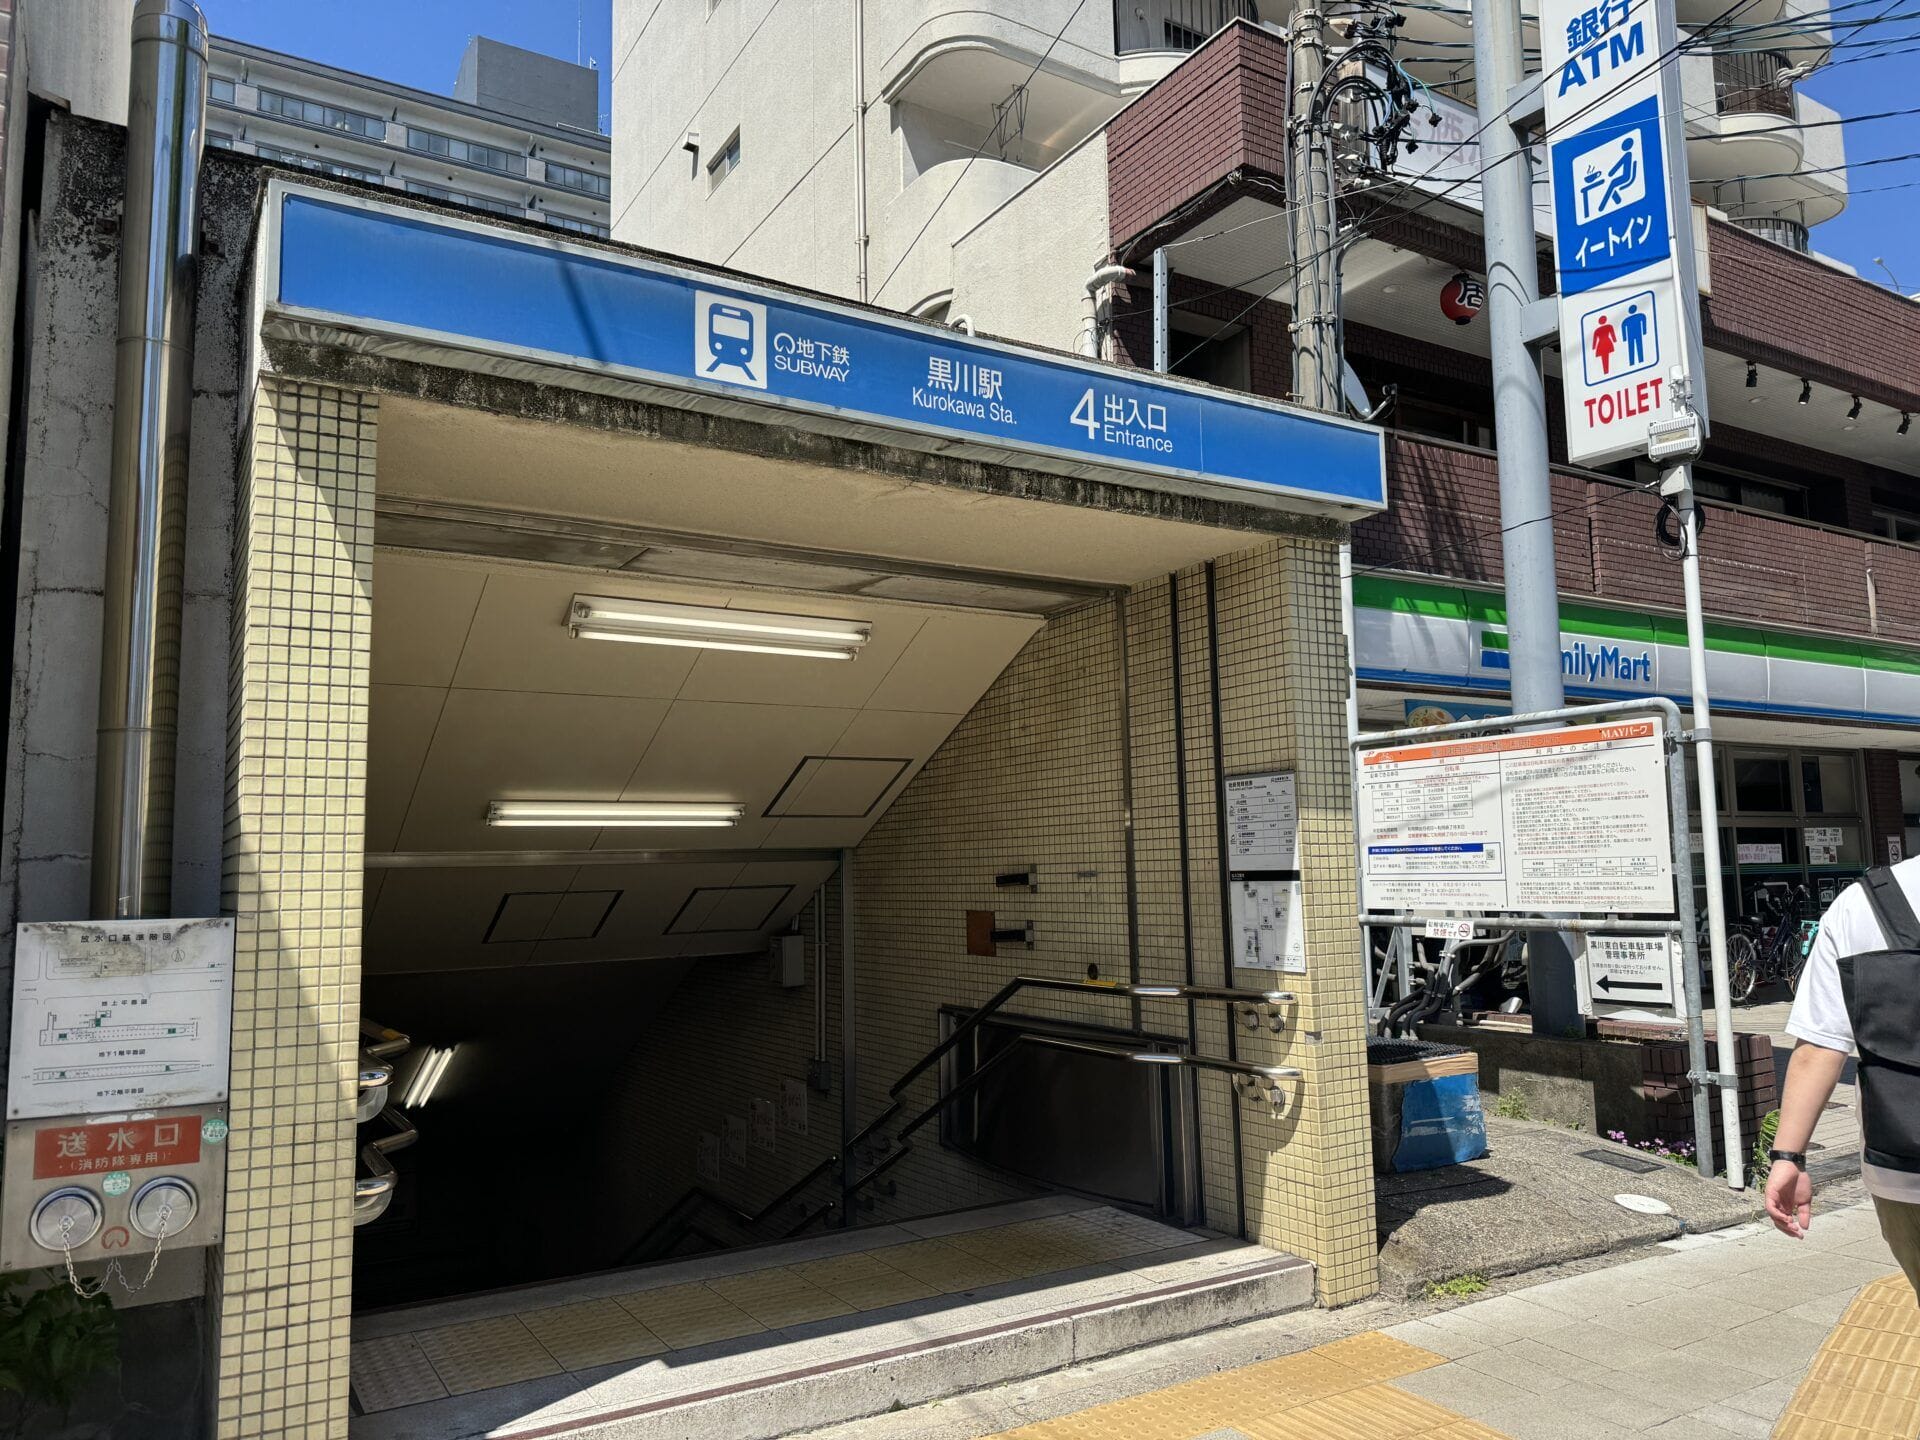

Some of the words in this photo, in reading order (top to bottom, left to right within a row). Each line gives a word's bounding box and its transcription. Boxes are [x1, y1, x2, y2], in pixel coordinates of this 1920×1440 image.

[1566, 0, 1634, 54] 銀行
[1558, 20, 1644, 98] ATM
[1575, 214, 1652, 268] イートイン
[774, 354, 850, 383] SUBWAY
[796, 336, 850, 366] 地下鉄
[927, 356, 1003, 401] 黒川駅
[912, 386, 985, 419] Kurokawa
[989, 402, 1017, 425] Sta.
[1070, 388, 1100, 440] 4
[1103, 394, 1167, 433] 出入口
[1584, 377, 1663, 428] TOILET
[1103, 424, 1173, 453] Entrance
[1560, 641, 1651, 682] milyMart
[1601, 726, 1648, 738] MAYパーク
[1590, 940, 1664, 951] 黒川東自転車駐車場
[1605, 950, 1646, 960] 管理事務所
[57, 1123, 179, 1158] 送水口
